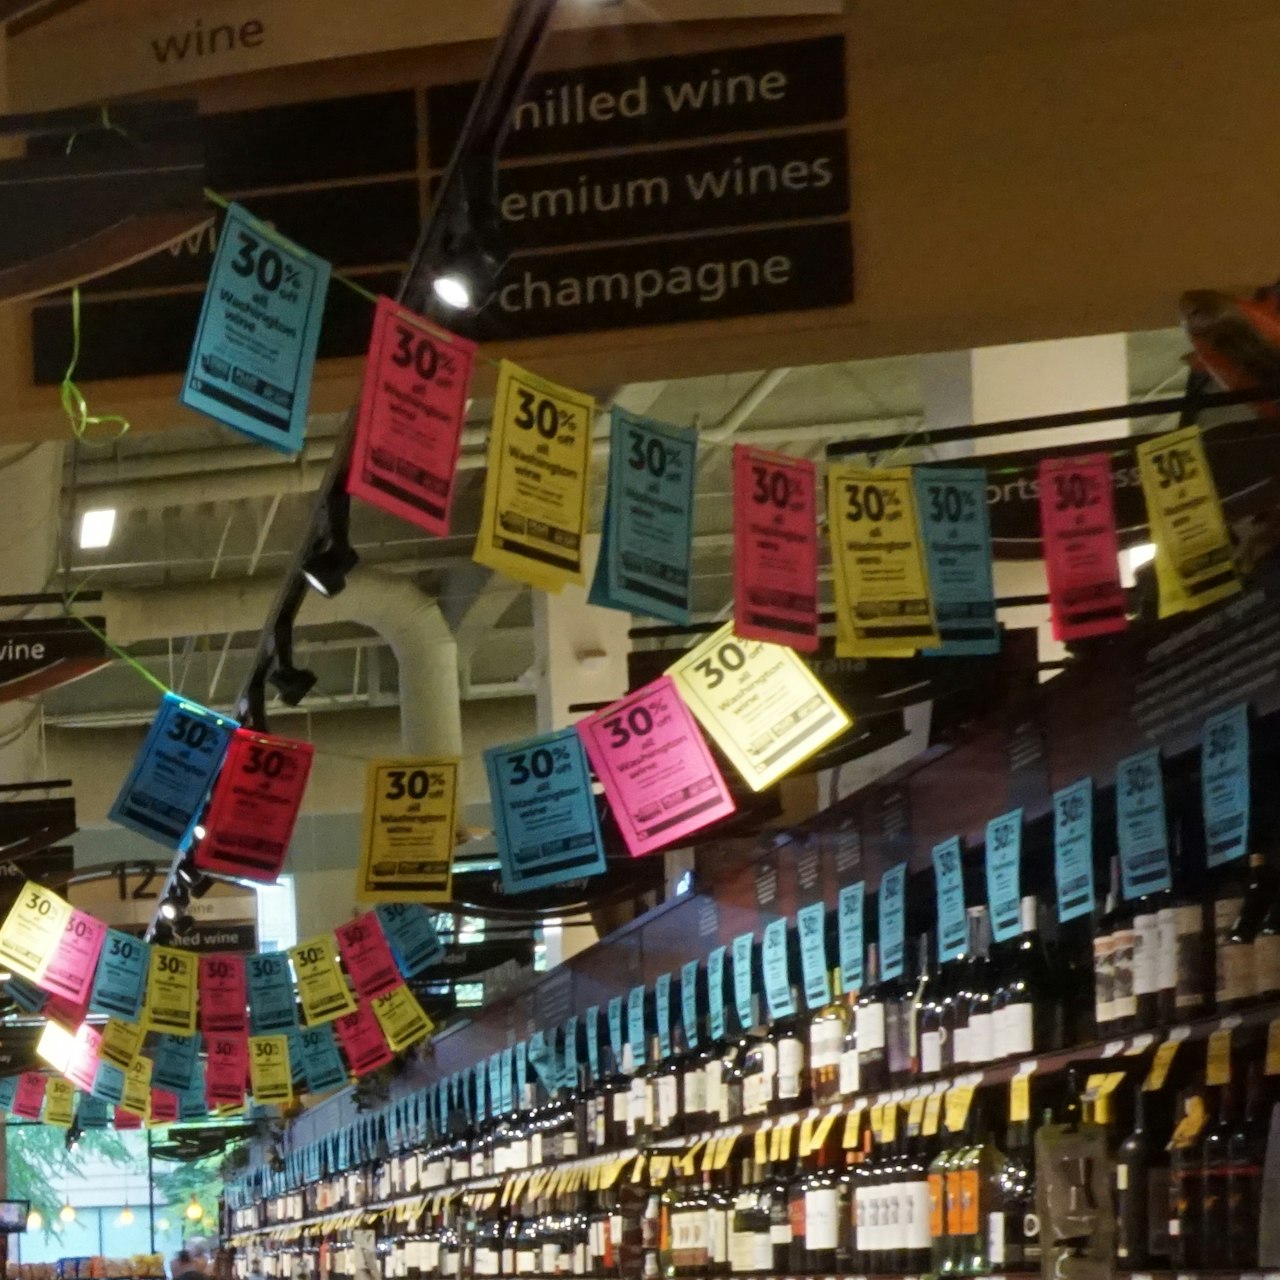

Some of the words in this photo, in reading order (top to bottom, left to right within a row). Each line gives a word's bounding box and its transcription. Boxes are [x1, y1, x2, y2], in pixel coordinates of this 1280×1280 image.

[150, 18, 265, 64] wine
[664, 68, 788, 113] wine
[686, 154, 833, 200] wines
[229, 231, 303, 292] 30%
[500, 254, 792, 312] champagne
[217, 288, 297, 339] Washington
[223, 310, 256, 335] wine
[391, 324, 458, 381] 30%
[513, 387, 578, 440] 30%
[507, 443, 580, 480] Washington
[627, 429, 683, 479] 30%
[844, 483, 903, 523] 30%
[717, 660, 785, 711] Washington
[602, 696, 668, 749] 30%
[506, 745, 571, 786] 30%
[616, 735, 688, 773] Washington
[629, 761, 658, 780] wine
[385, 770, 445, 800] 30%
[380, 813, 447, 823] Washington
[111, 861, 159, 900] 12
[210, 932, 239, 945] wine
